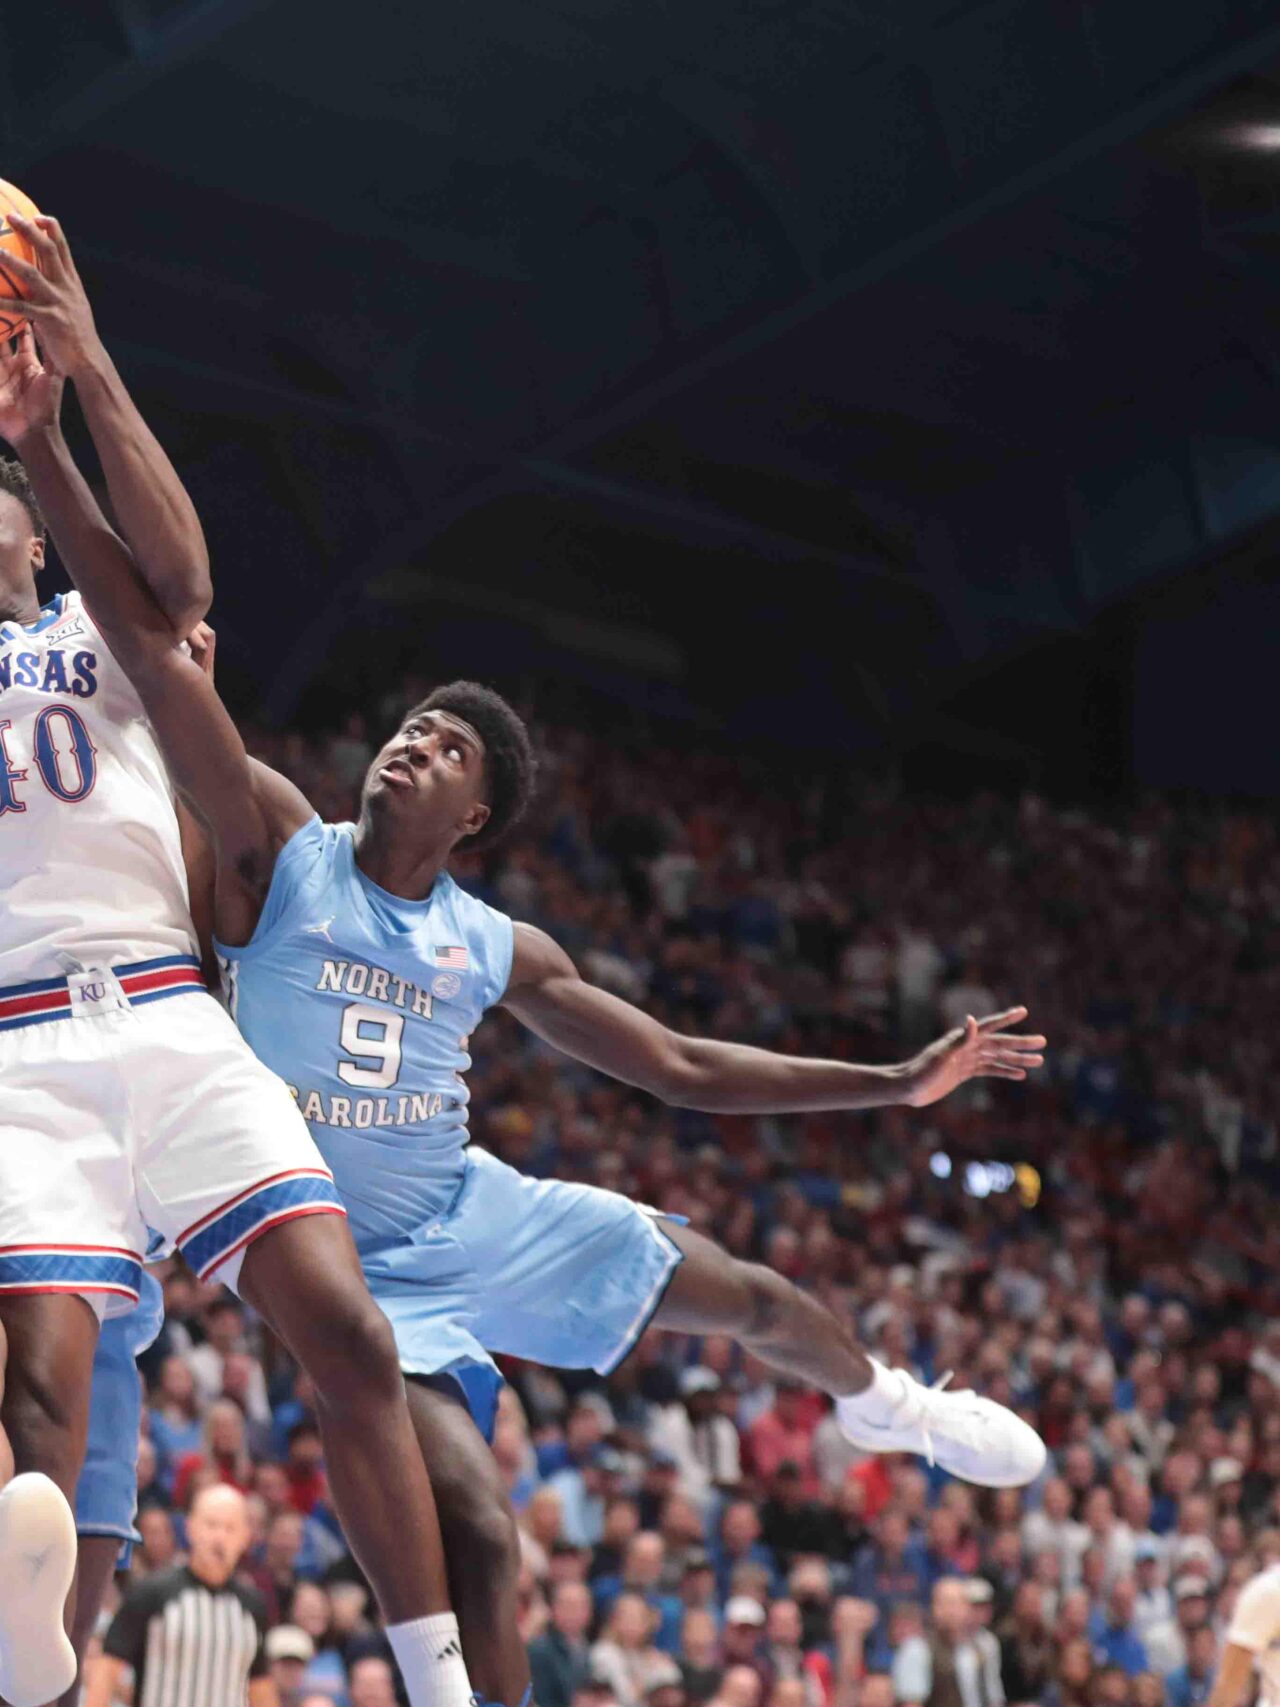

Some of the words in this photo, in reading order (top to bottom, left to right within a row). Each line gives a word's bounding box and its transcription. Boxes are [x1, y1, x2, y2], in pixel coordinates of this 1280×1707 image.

[78, 981, 107, 1008] KU
[316, 960, 434, 1021] NORTH
[337, 1002, 406, 1090] 9
